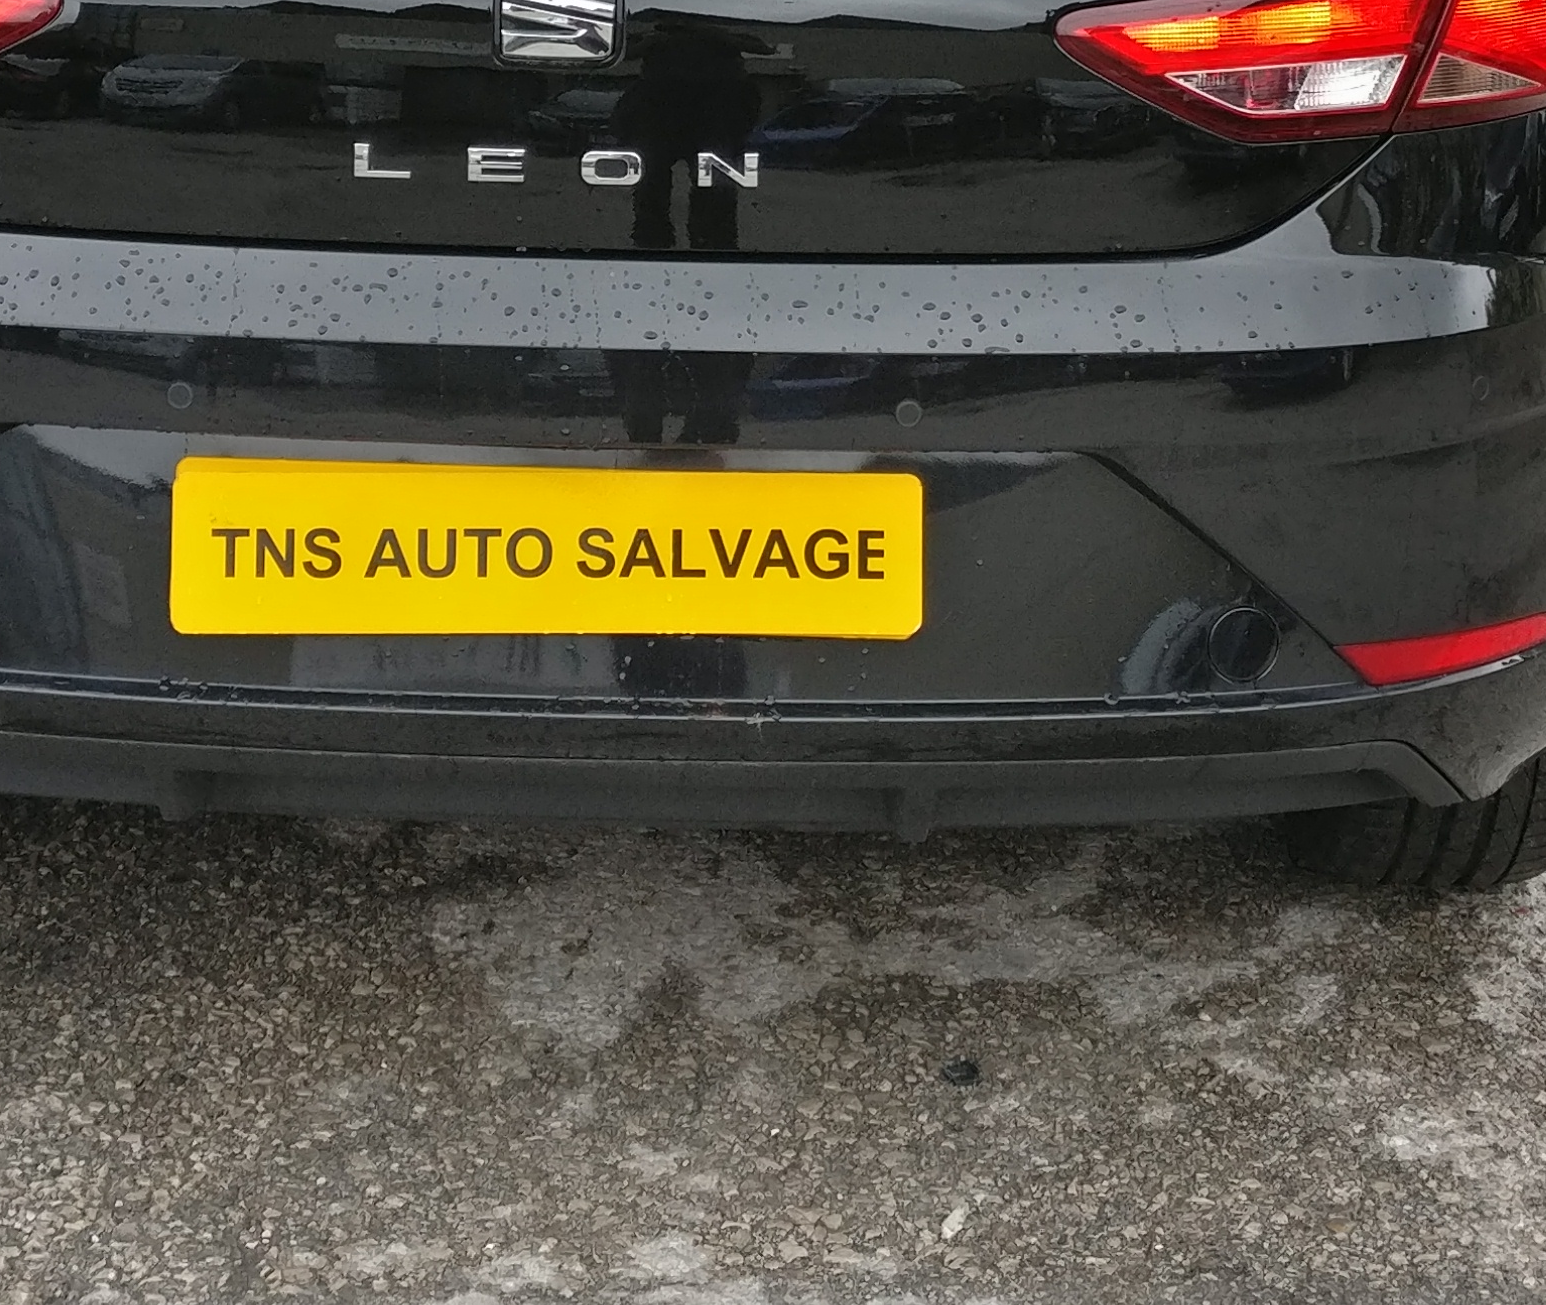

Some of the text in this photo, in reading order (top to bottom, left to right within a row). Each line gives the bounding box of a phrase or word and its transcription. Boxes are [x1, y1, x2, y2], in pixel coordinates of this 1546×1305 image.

[354, 143, 759, 187] LEON
[211, 527, 885, 579] TNS AUTO SALVAGE
